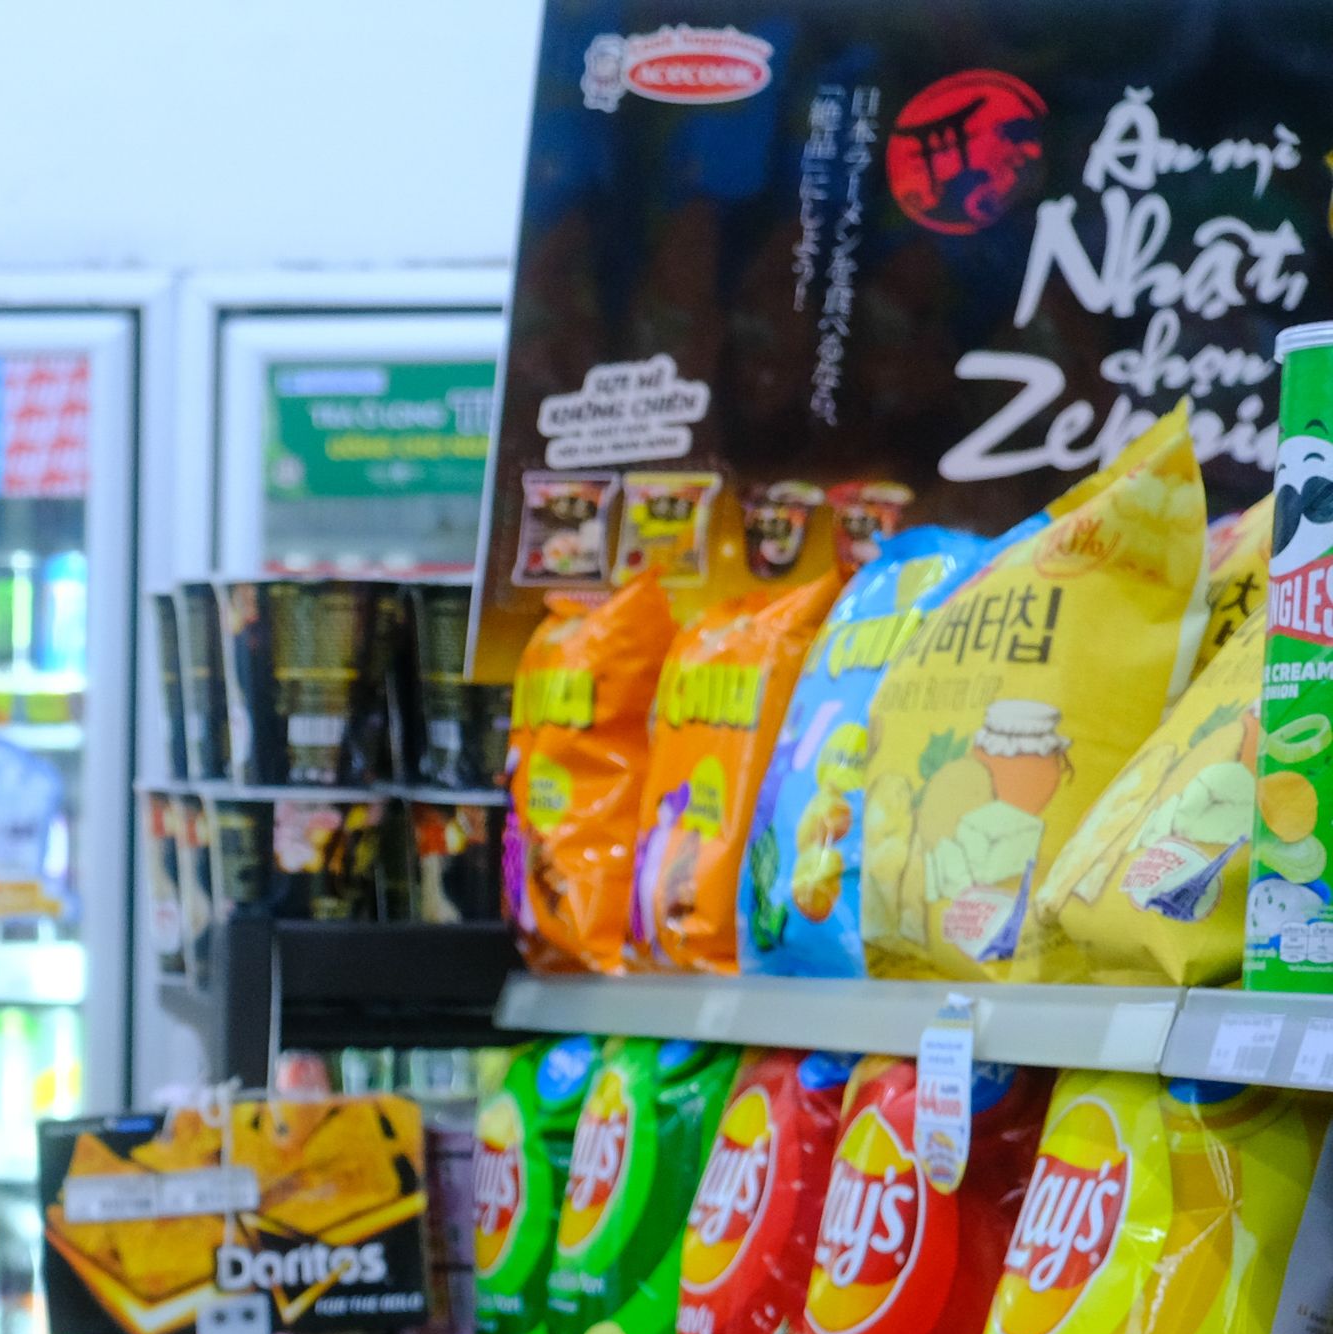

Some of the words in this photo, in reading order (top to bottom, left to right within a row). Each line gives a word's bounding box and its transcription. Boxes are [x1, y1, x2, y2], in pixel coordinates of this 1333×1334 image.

[1082, 84, 1203, 192] Ăn
[1206, 122, 1301, 199] mì
[216, 1242, 387, 1291] Doritos
[1004, 1156, 1121, 1292] Lay's
